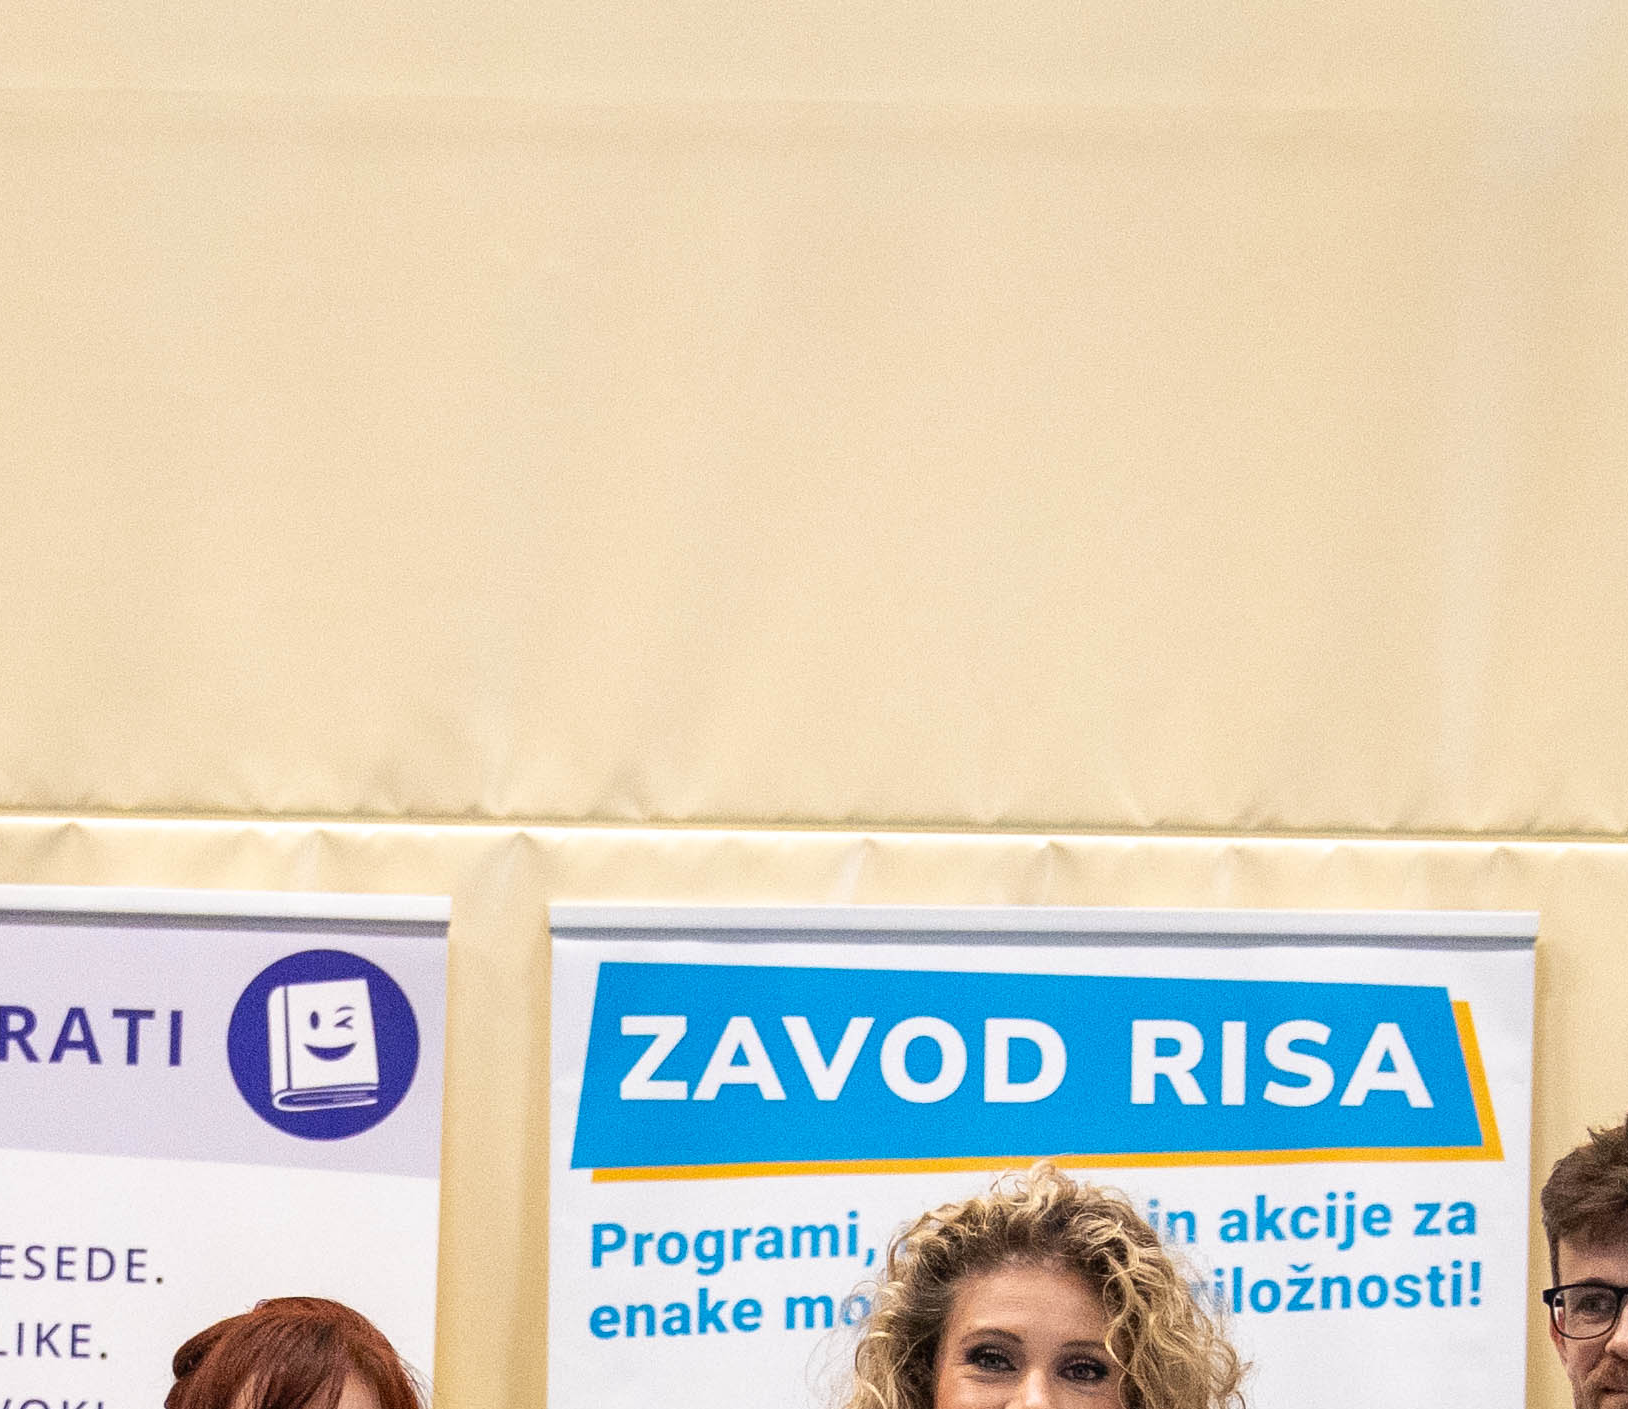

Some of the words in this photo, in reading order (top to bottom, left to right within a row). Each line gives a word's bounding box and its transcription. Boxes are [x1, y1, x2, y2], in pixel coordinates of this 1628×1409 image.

[618, 1014, 1068, 1107] ZAVOD
[1130, 1018, 1434, 1109] RISA
[591, 1210, 878, 1277] Programi,
[1147, 1198, 1196, 1245] in
[1218, 1191, 1393, 1251] akcije
[1412, 1200, 1478, 1237] za
[589, 1288, 763, 1339] enake
[784, 1295, 873, 1330] mo
